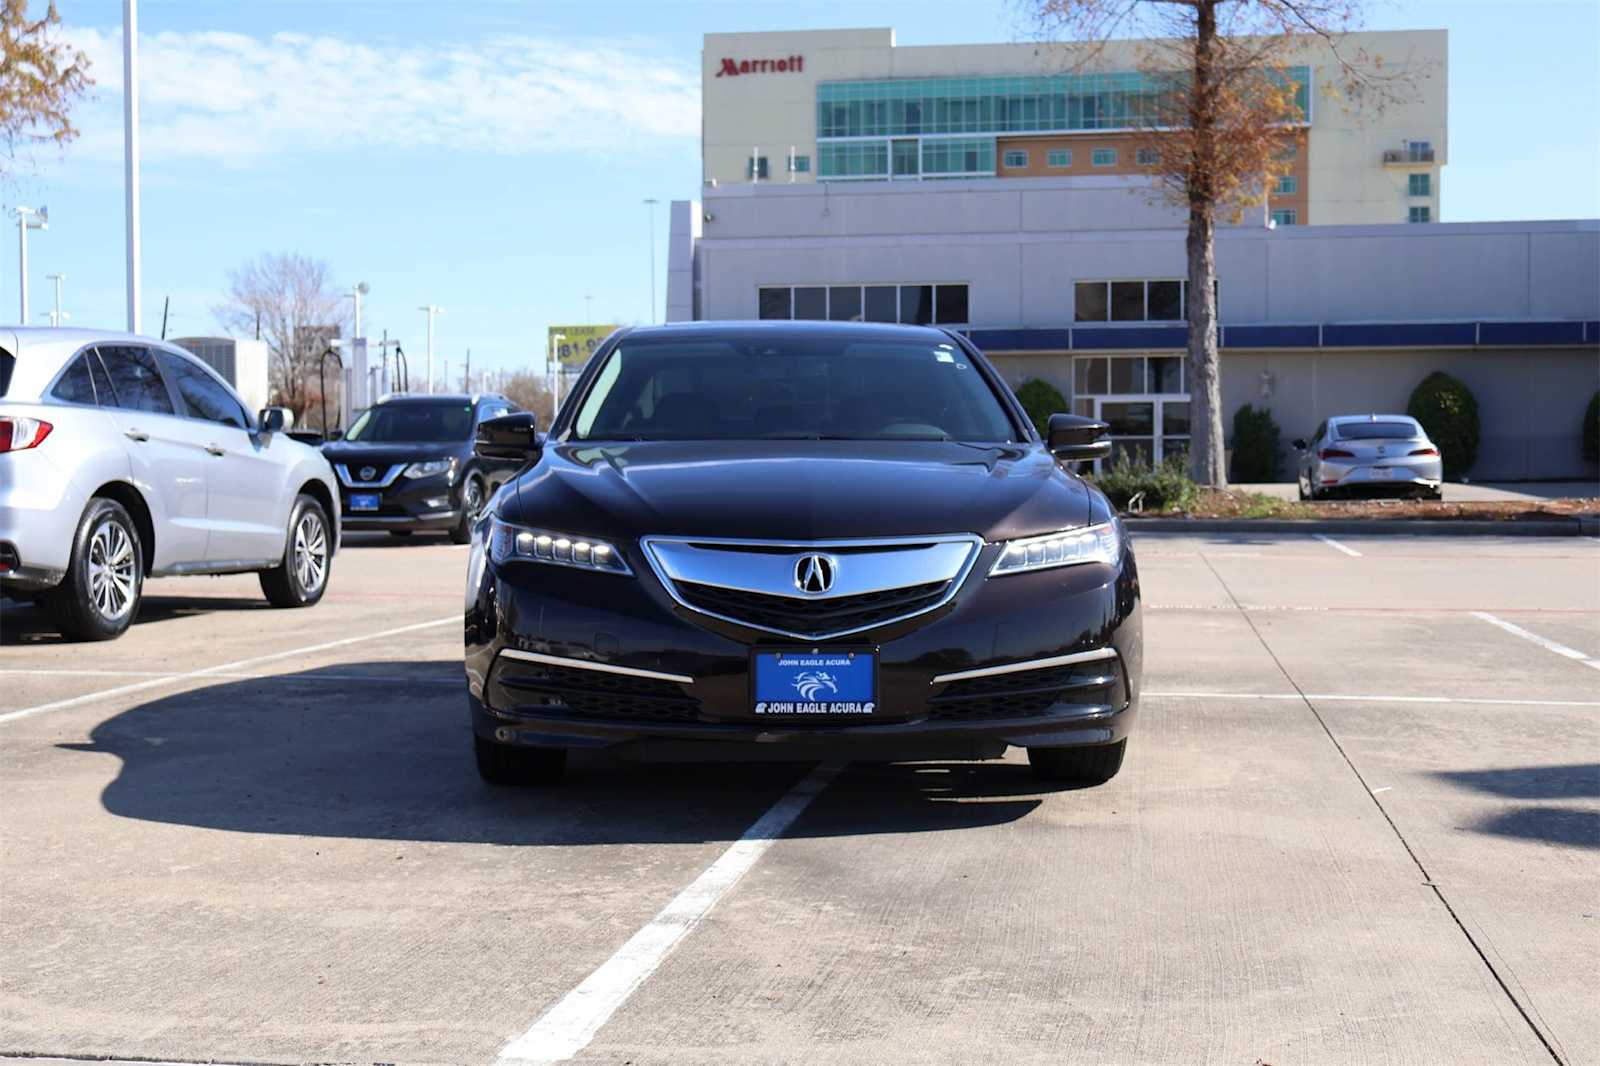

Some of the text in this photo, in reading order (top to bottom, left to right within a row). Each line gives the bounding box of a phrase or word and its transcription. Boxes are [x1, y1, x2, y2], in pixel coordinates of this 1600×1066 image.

[715, 55, 803, 77] Marriott
[767, 702, 861, 713] JOHN EAGLE ACURA
